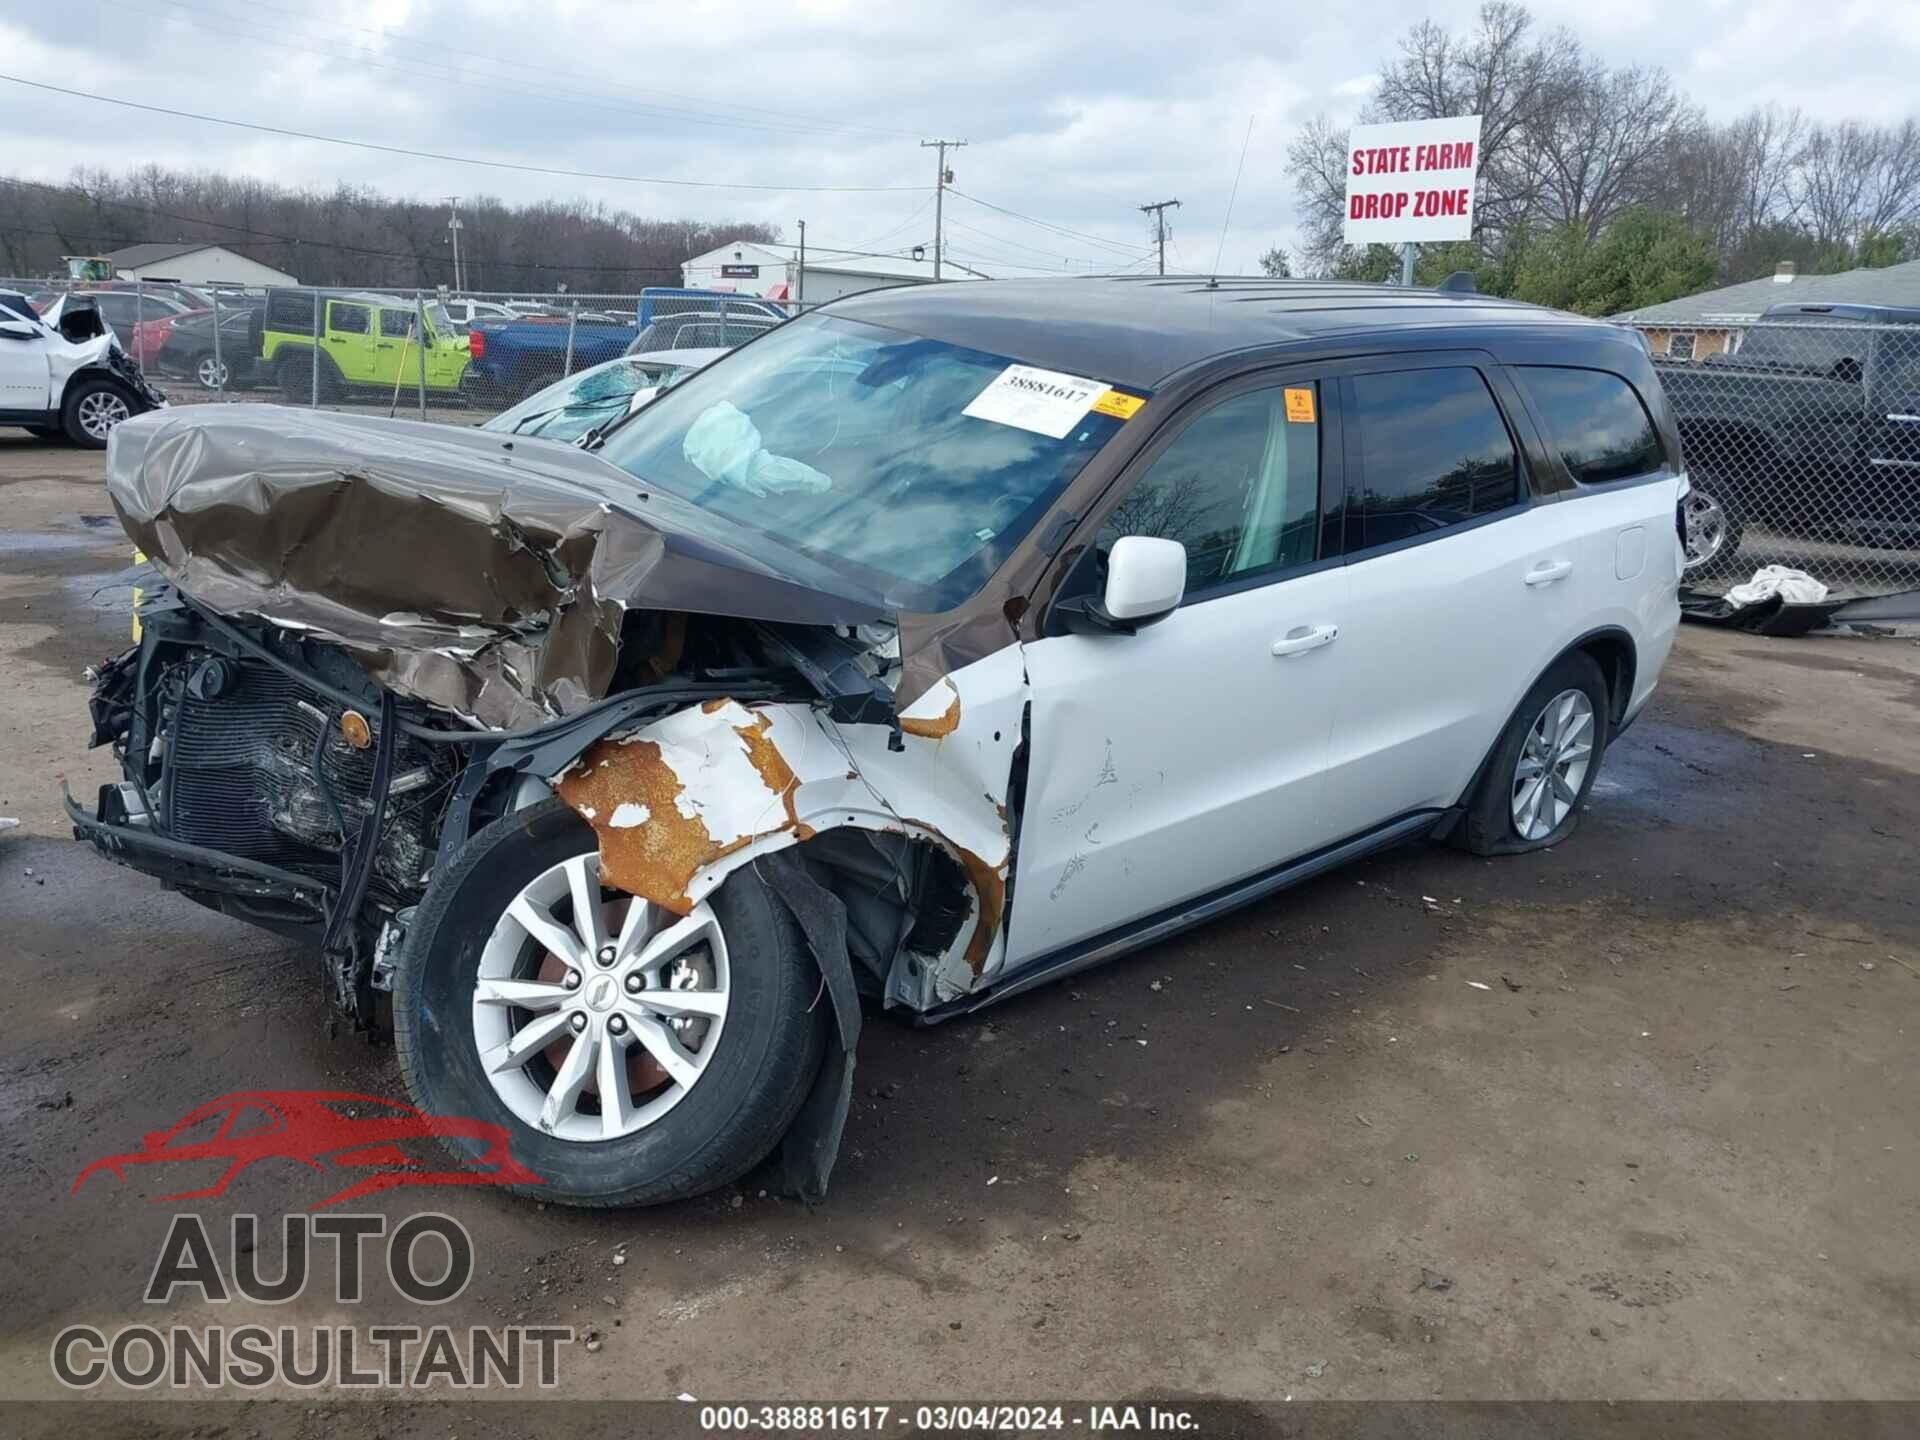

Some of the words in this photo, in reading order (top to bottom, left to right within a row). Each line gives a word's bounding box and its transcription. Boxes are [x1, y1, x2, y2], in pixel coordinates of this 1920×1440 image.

[1352, 146, 1411, 176] STATE
[1415, 142, 1474, 171] FARM
[1350, 193, 1409, 220] DROP
[1413, 189, 1469, 218] ZONE
[1005, 376, 1088, 402] 38881617
